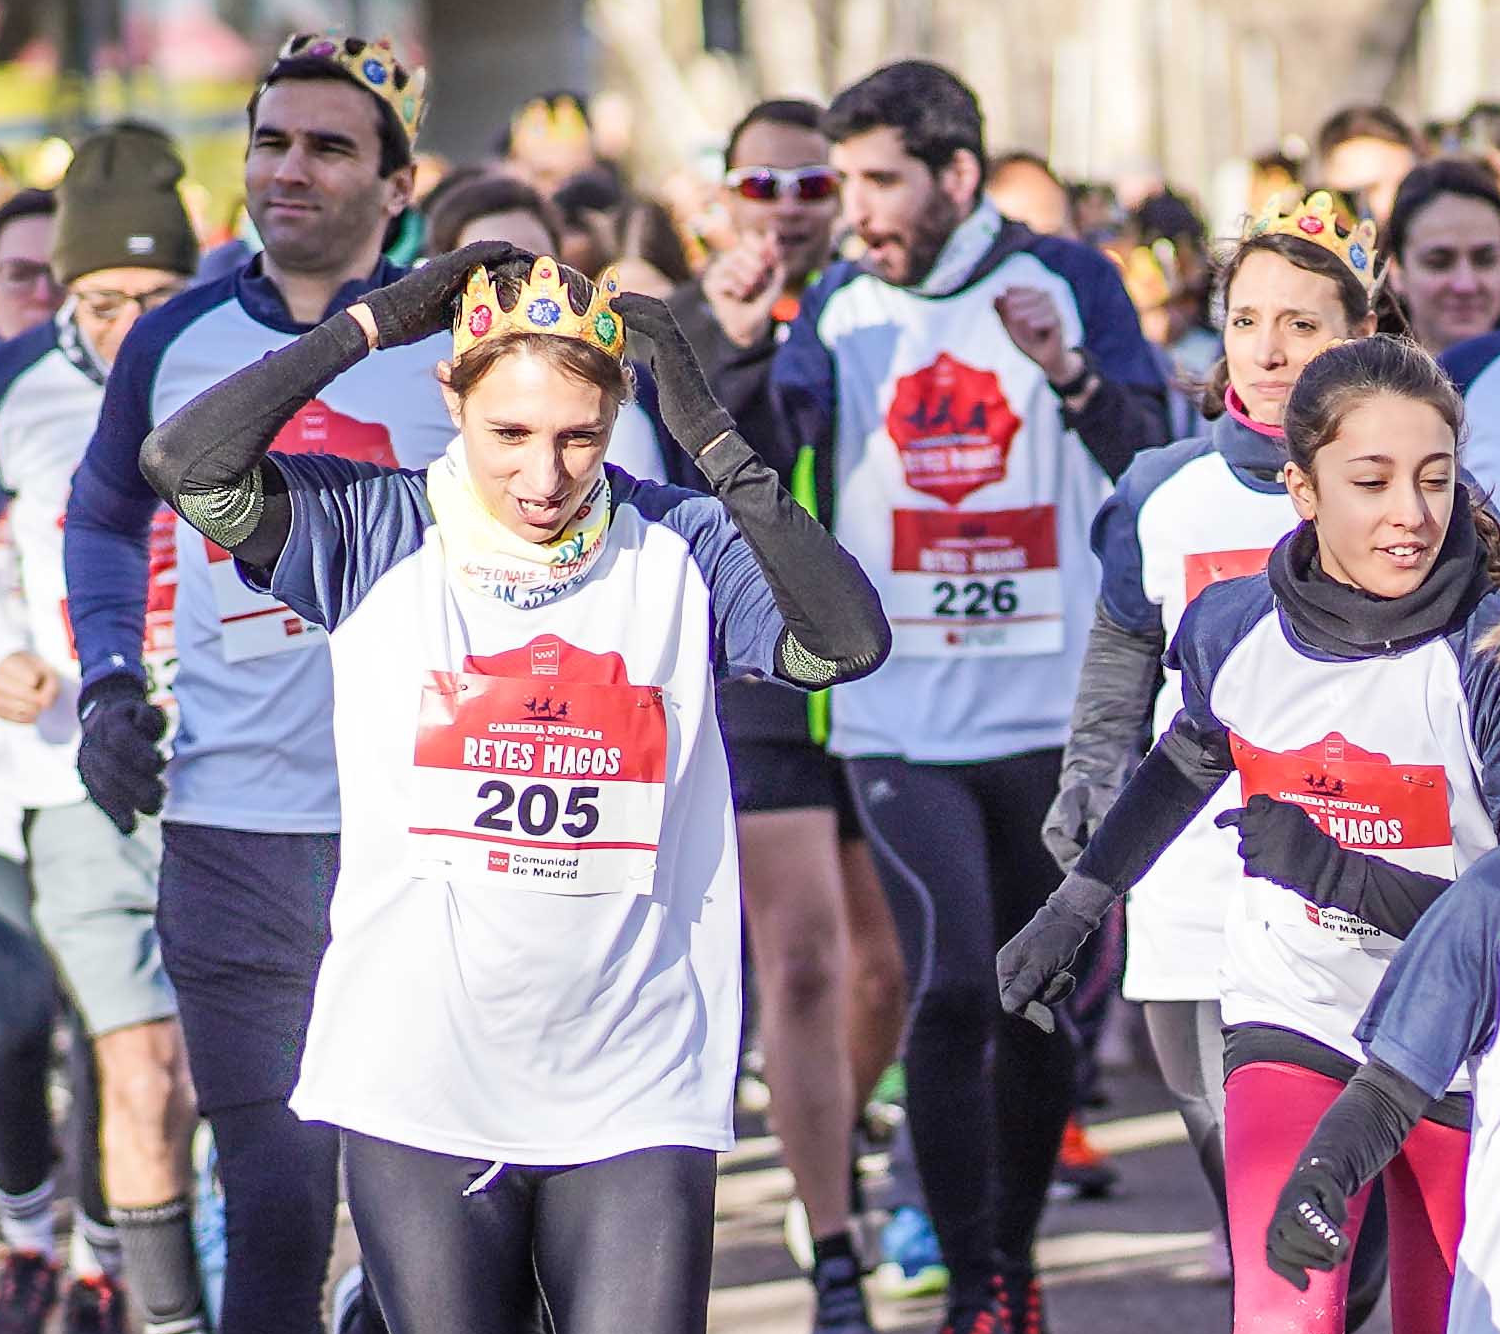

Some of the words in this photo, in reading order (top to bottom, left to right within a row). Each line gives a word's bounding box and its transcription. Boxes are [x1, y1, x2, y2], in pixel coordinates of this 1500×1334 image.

[932, 579, 1018, 617] 226
[487, 722, 545, 735] CARRERA
[546, 725, 604, 741] POPULAR
[462, 736, 535, 771] REYES
[542, 744, 622, 776] MAGOS
[474, 779, 600, 839] 205
[1279, 790, 1326, 807] CARRERA
[1327, 799, 1381, 815] POPULAR
[1328, 816, 1403, 845] MAGOS
[513, 854, 580, 867] Comunidad
[512, 866, 528, 877] de
[533, 867, 578, 880] Madrid
[1321, 909, 1369, 925] Comuni
[1322, 920, 1336, 930] de
[1339, 921, 1381, 936] Madrid
